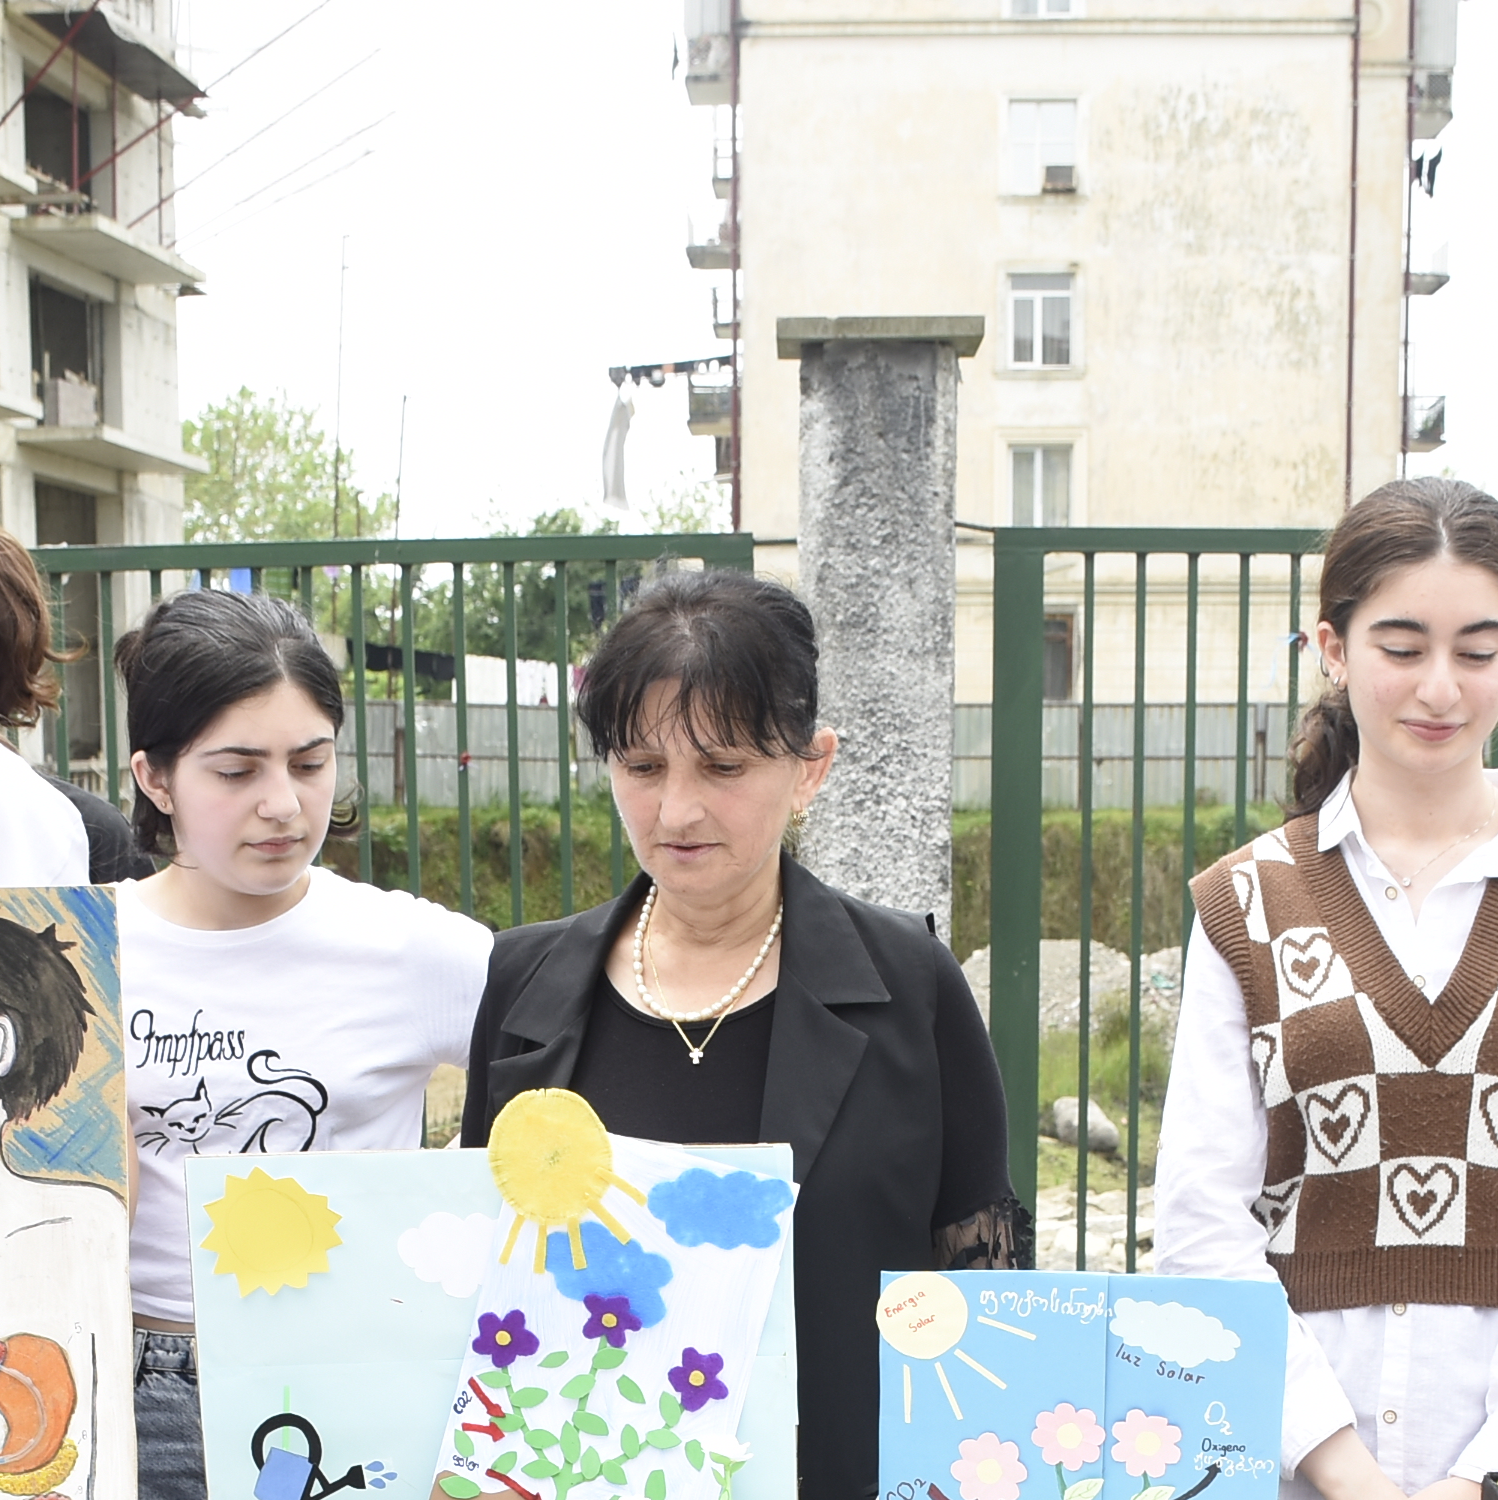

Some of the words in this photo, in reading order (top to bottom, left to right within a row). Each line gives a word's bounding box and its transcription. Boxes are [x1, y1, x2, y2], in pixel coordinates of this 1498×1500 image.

[883, 1290, 927, 1319] Energia
[907, 1313, 937, 1333] Solar
[1115, 1342, 1142, 1369] luz
[1155, 1360, 1207, 1386] Solar
[1201, 1437, 1247, 1457] Oxigeno
